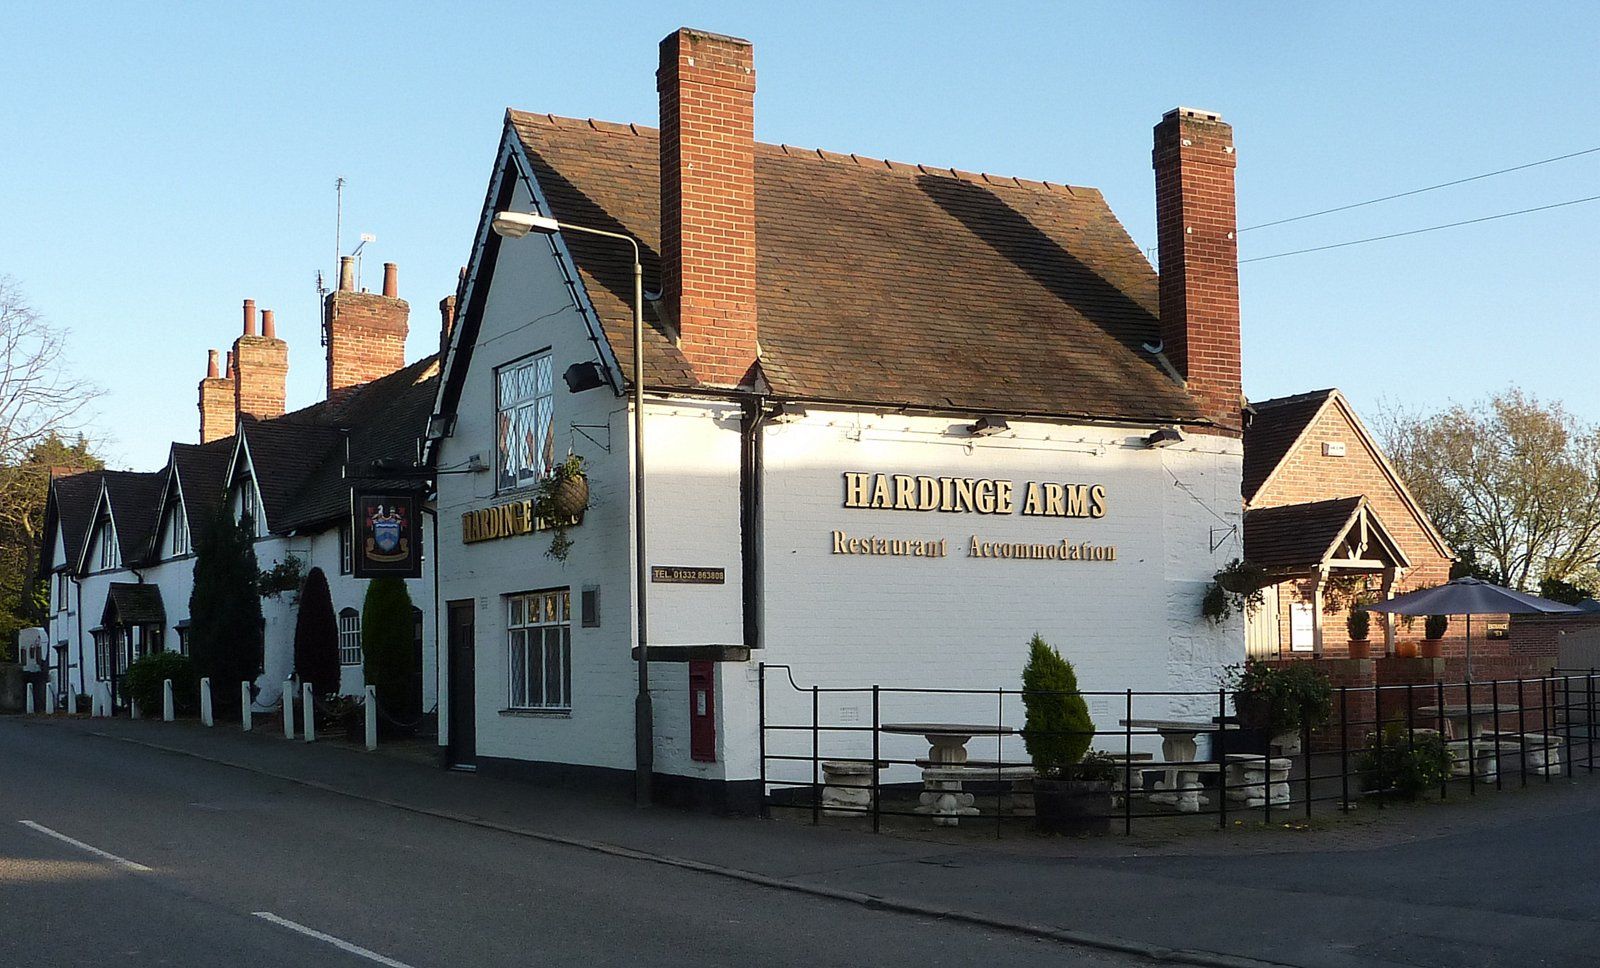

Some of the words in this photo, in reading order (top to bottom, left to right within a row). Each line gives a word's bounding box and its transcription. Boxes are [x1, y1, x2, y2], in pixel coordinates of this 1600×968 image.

[842, 472, 1013, 514] HARDINGE
[1023, 481, 1106, 518] ARMS
[462, 499, 533, 544] HARDINGE
[831, 530, 947, 557] Restaurant
[968, 535, 1118, 561] Accommodation
[673, 570, 696, 579] 01332
